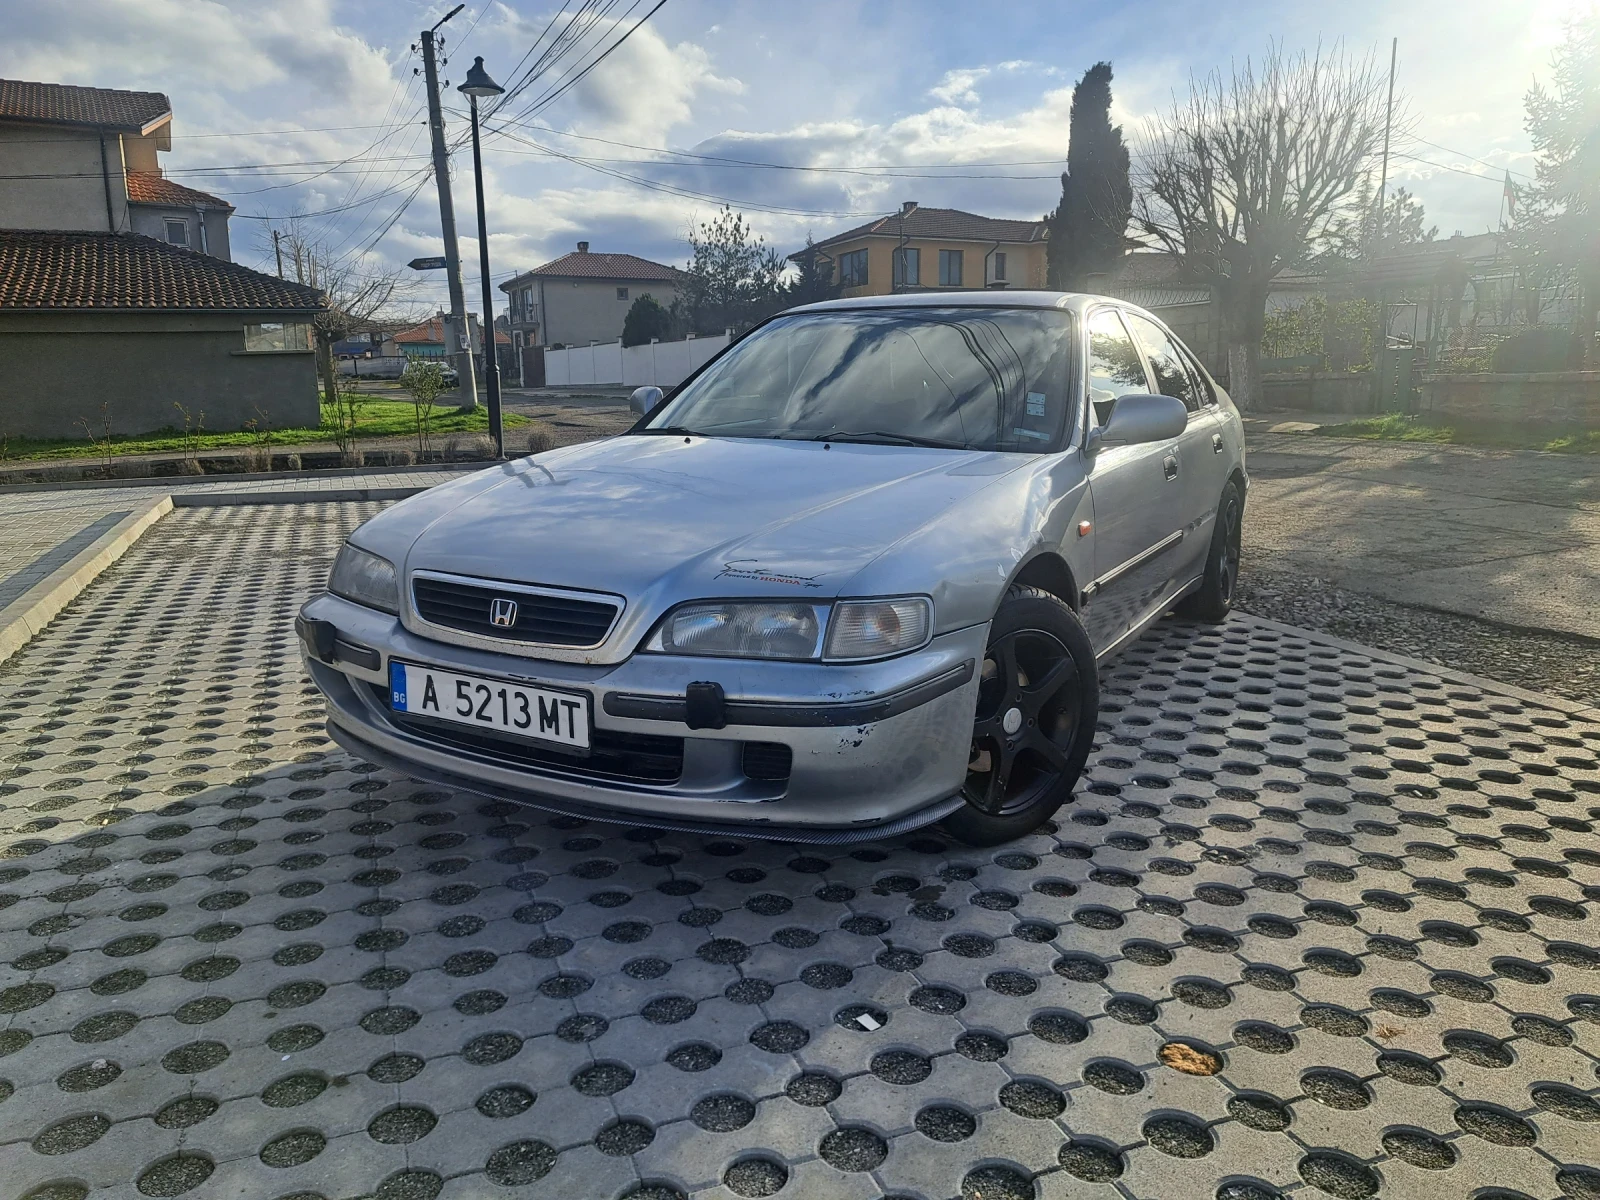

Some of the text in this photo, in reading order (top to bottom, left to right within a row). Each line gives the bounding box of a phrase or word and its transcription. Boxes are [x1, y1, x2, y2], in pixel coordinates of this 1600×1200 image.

[759, 576, 801, 586] HONDA
[393, 691, 406, 704] BG
[422, 674, 440, 712] A
